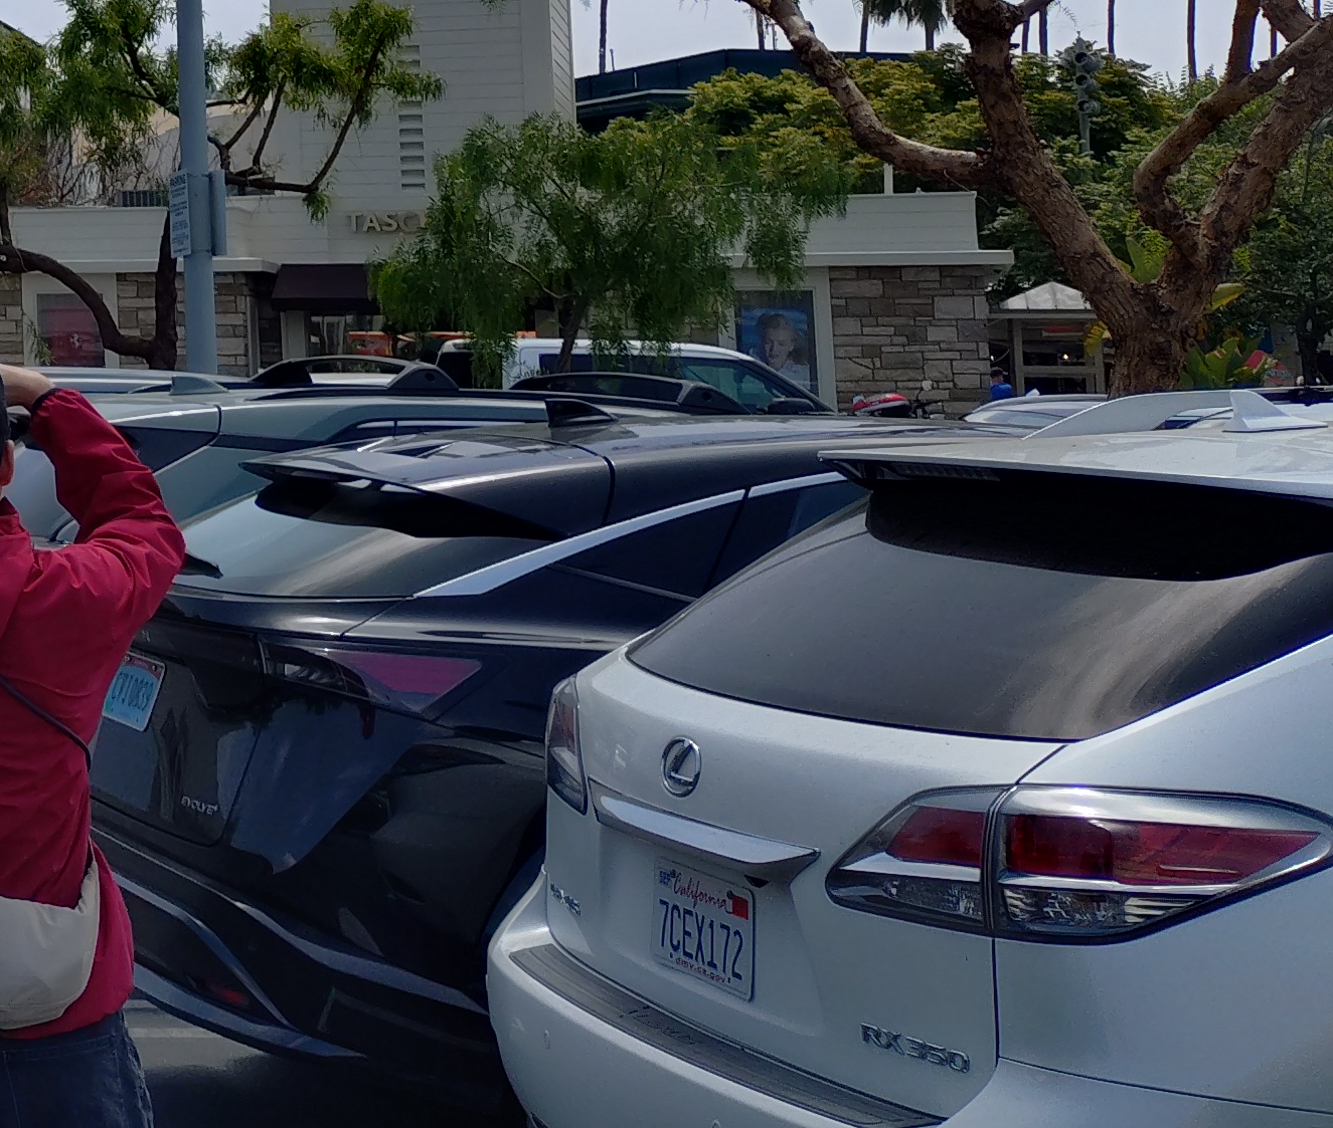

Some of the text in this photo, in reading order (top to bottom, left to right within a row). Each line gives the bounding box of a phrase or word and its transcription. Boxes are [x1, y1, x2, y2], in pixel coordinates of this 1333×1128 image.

[673, 871, 727, 909] California
[659, 899, 743, 980] 7CEX172
[860, 1022, 970, 1073] RX 350
